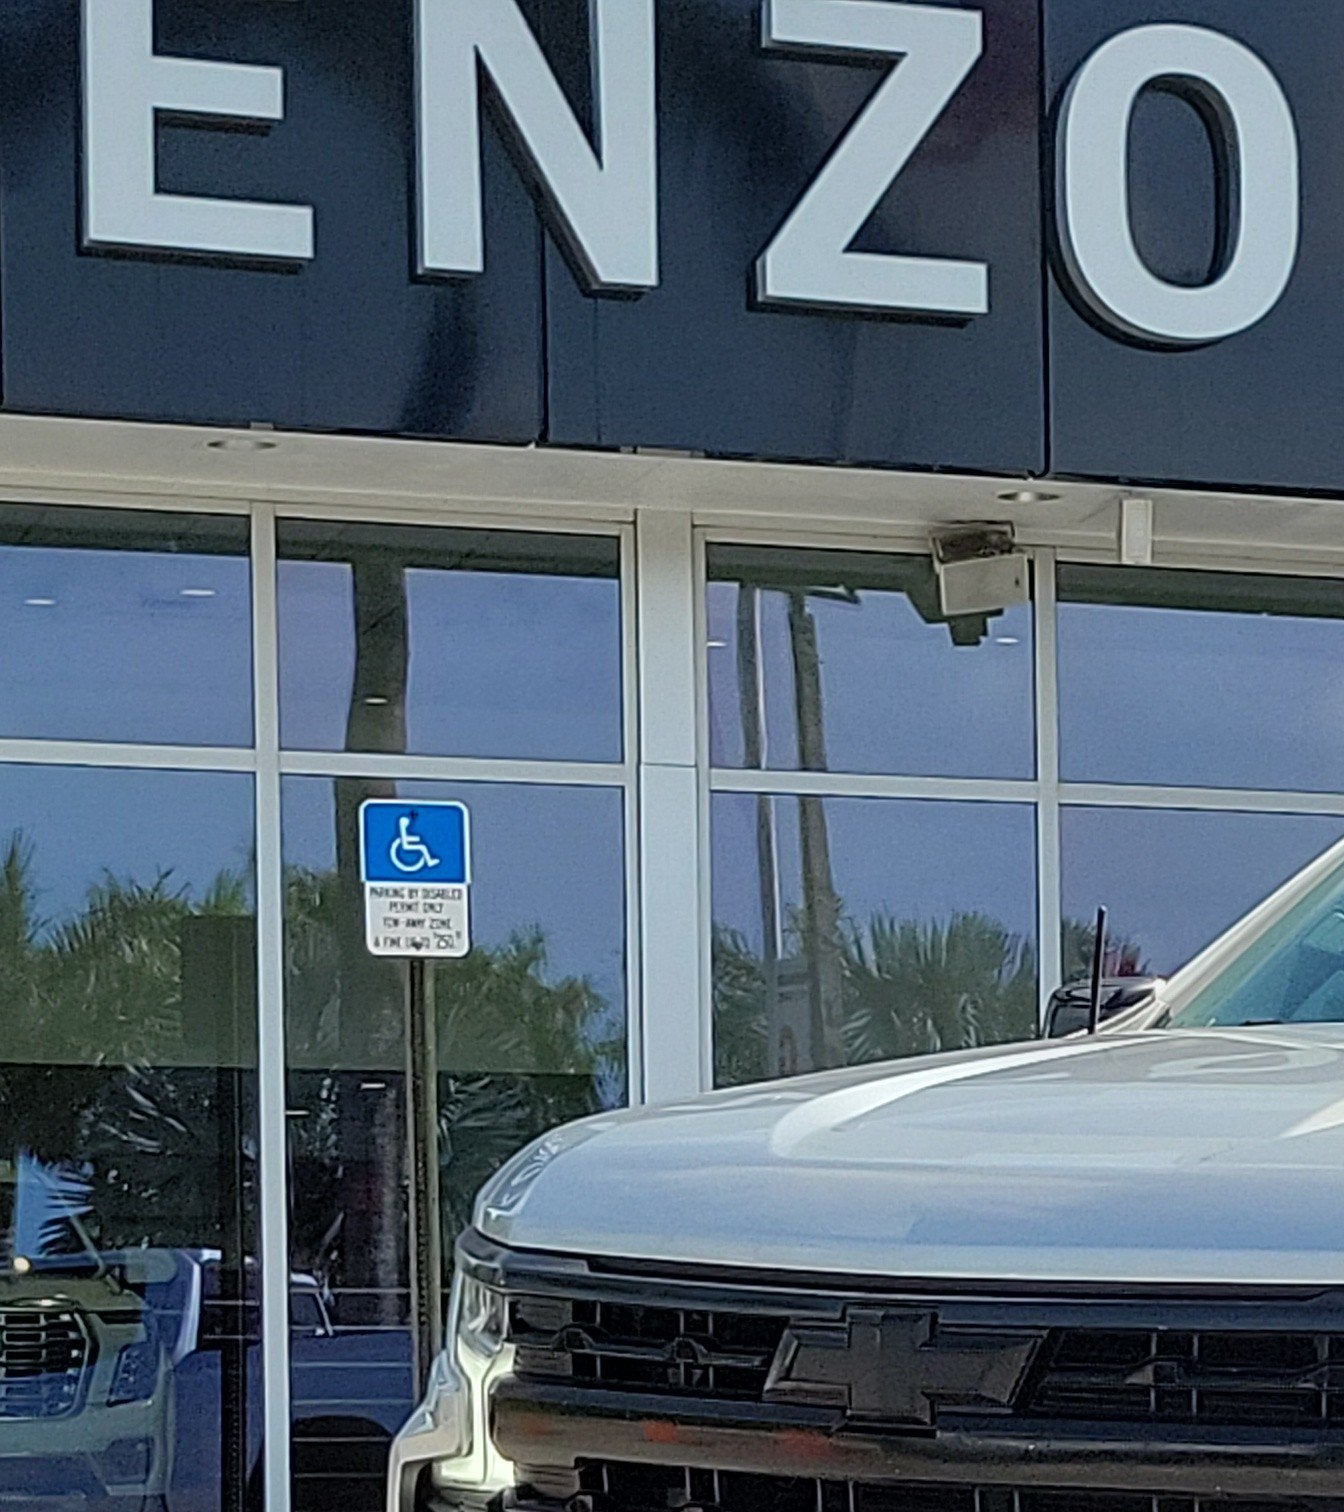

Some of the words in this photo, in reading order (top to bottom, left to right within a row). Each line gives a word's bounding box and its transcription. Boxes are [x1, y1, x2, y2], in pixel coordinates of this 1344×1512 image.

[82, 0, 1300, 346] ENZO
[408, 888, 418, 899] BY
[422, 888, 463, 900] DISABLED
[389, 901, 419, 913] PERMIT
[422, 902, 444, 914] ONLY
[429, 918, 452, 930] ZONE
